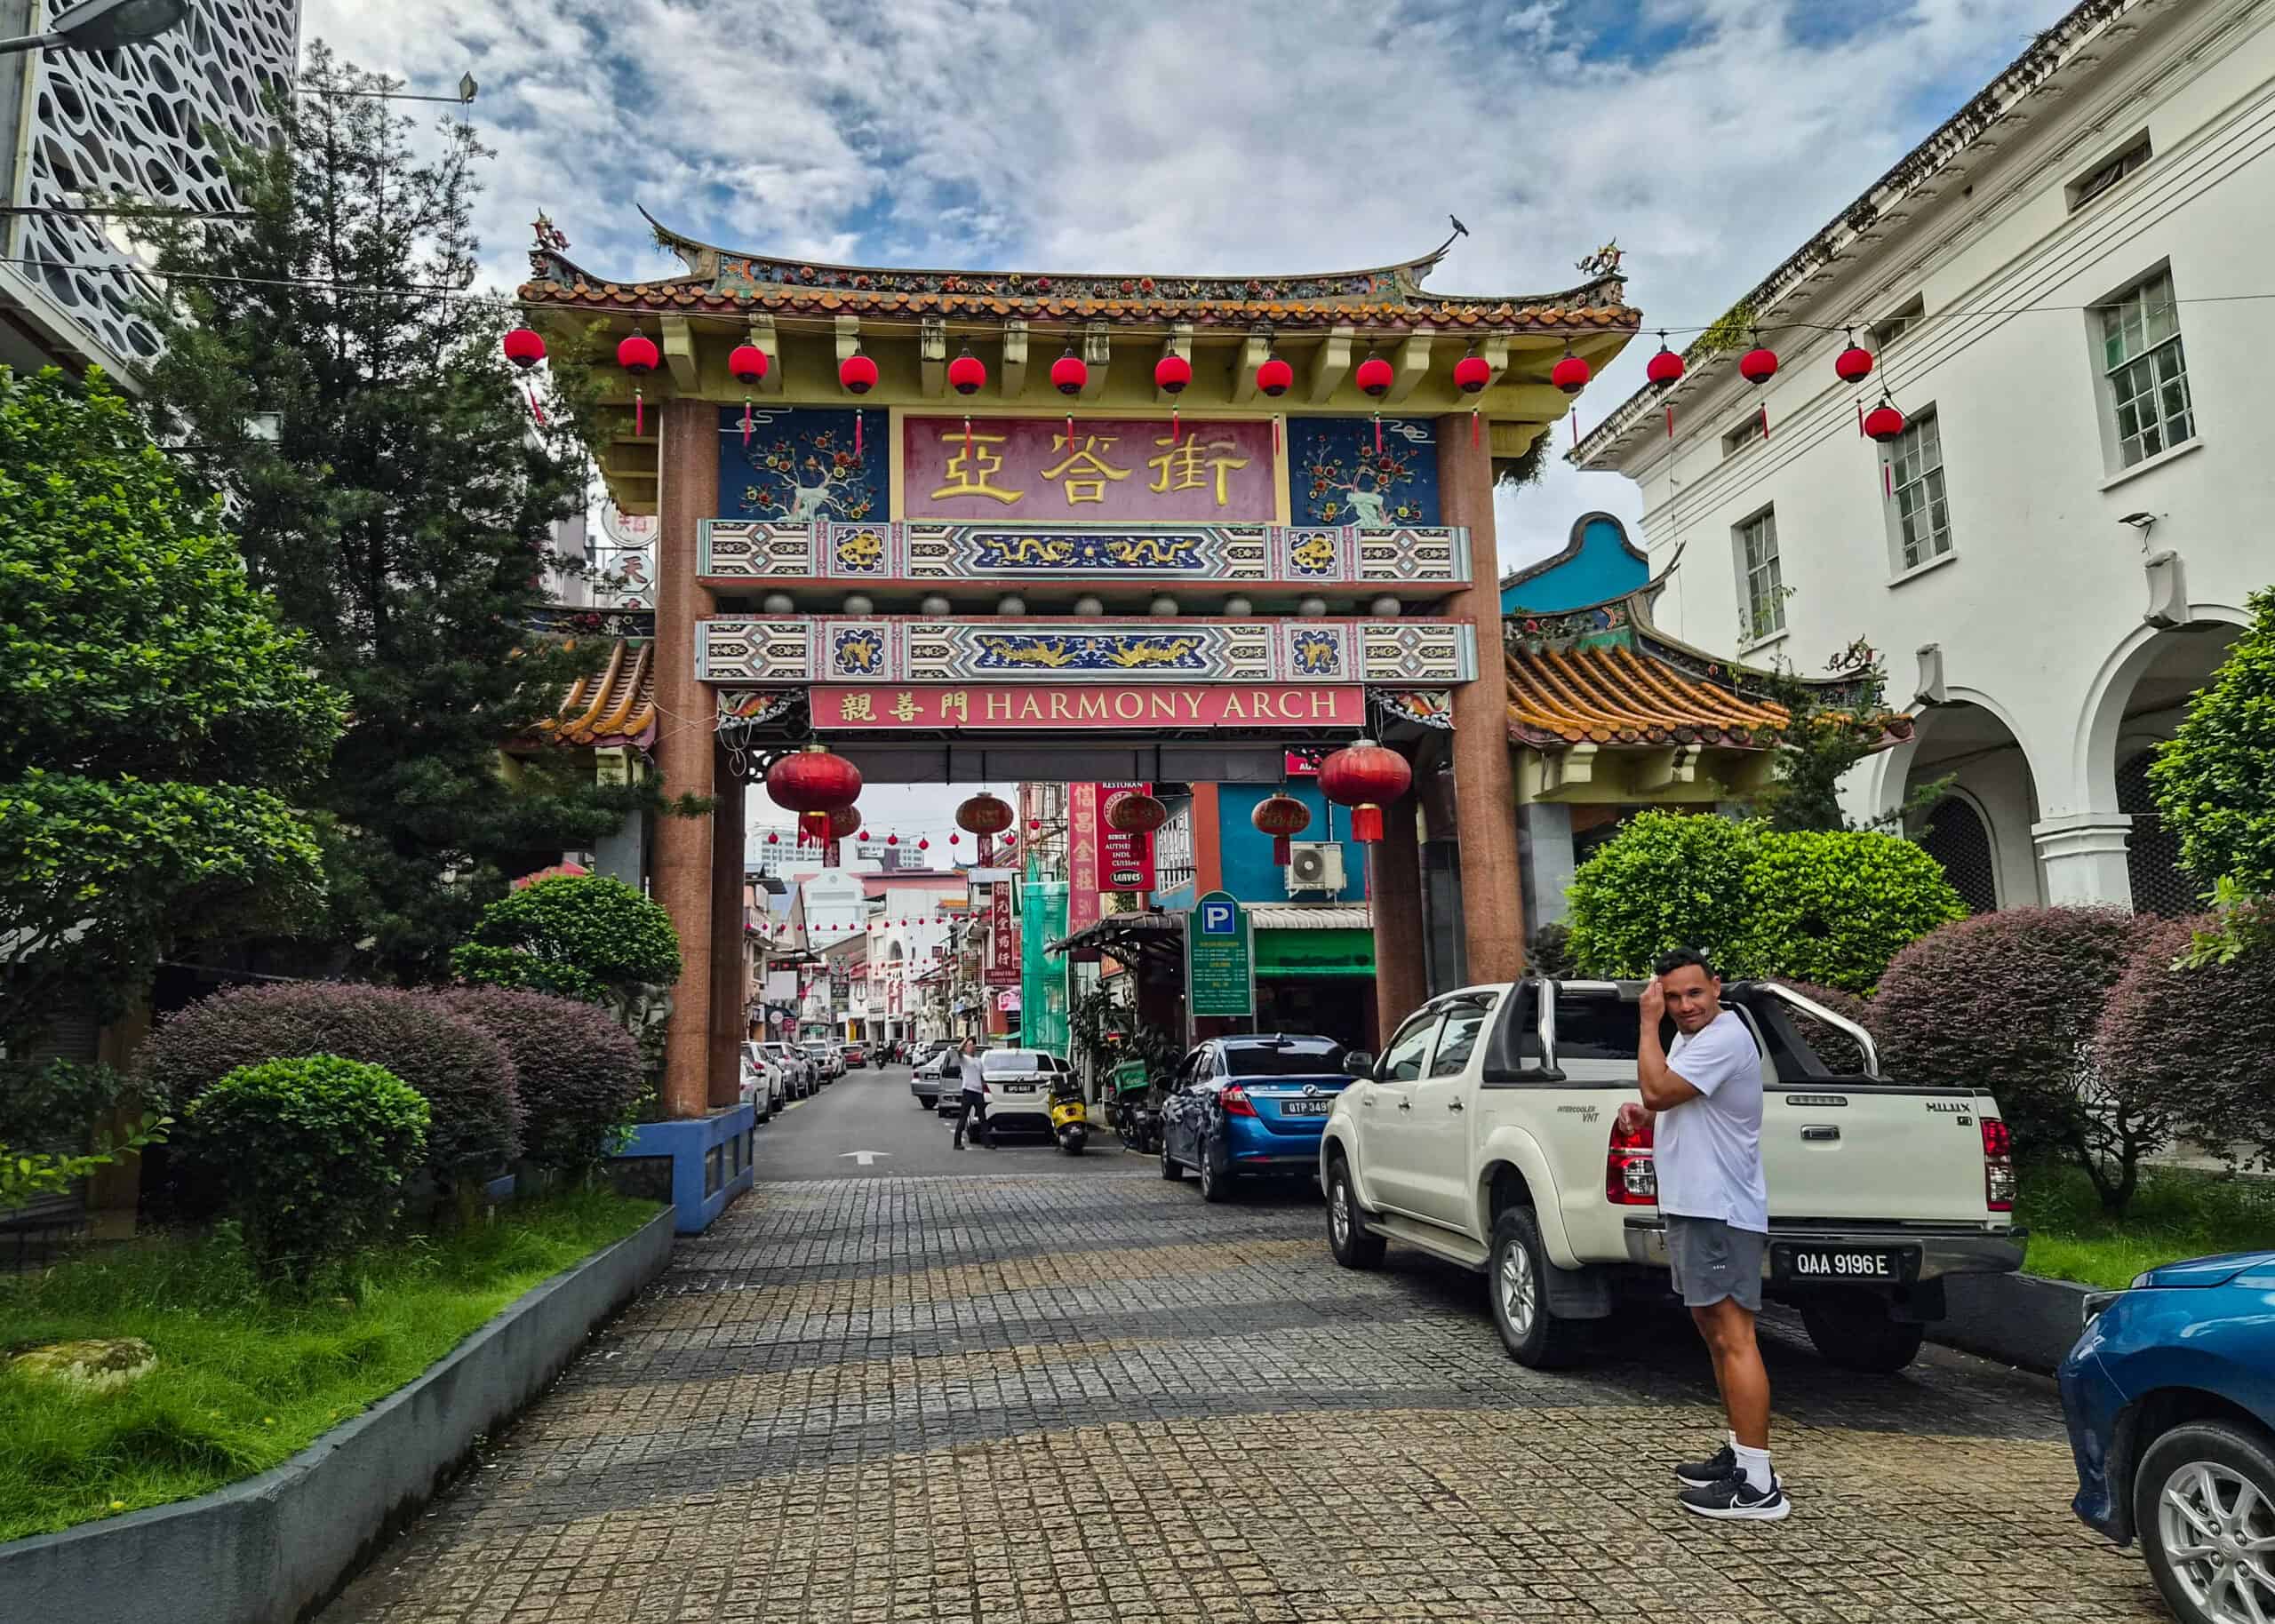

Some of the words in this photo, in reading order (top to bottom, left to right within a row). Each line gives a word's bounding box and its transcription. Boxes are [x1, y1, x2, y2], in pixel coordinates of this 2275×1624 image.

[840, 689, 969, 722] 親善門
[986, 691, 1206, 720] HARMONY
[1222, 691, 1337, 719] ARCH
[1208, 907, 1229, 929] P
[1583, 1112, 1600, 1123] VNT
[1797, 1254, 1831, 1273] QAA
